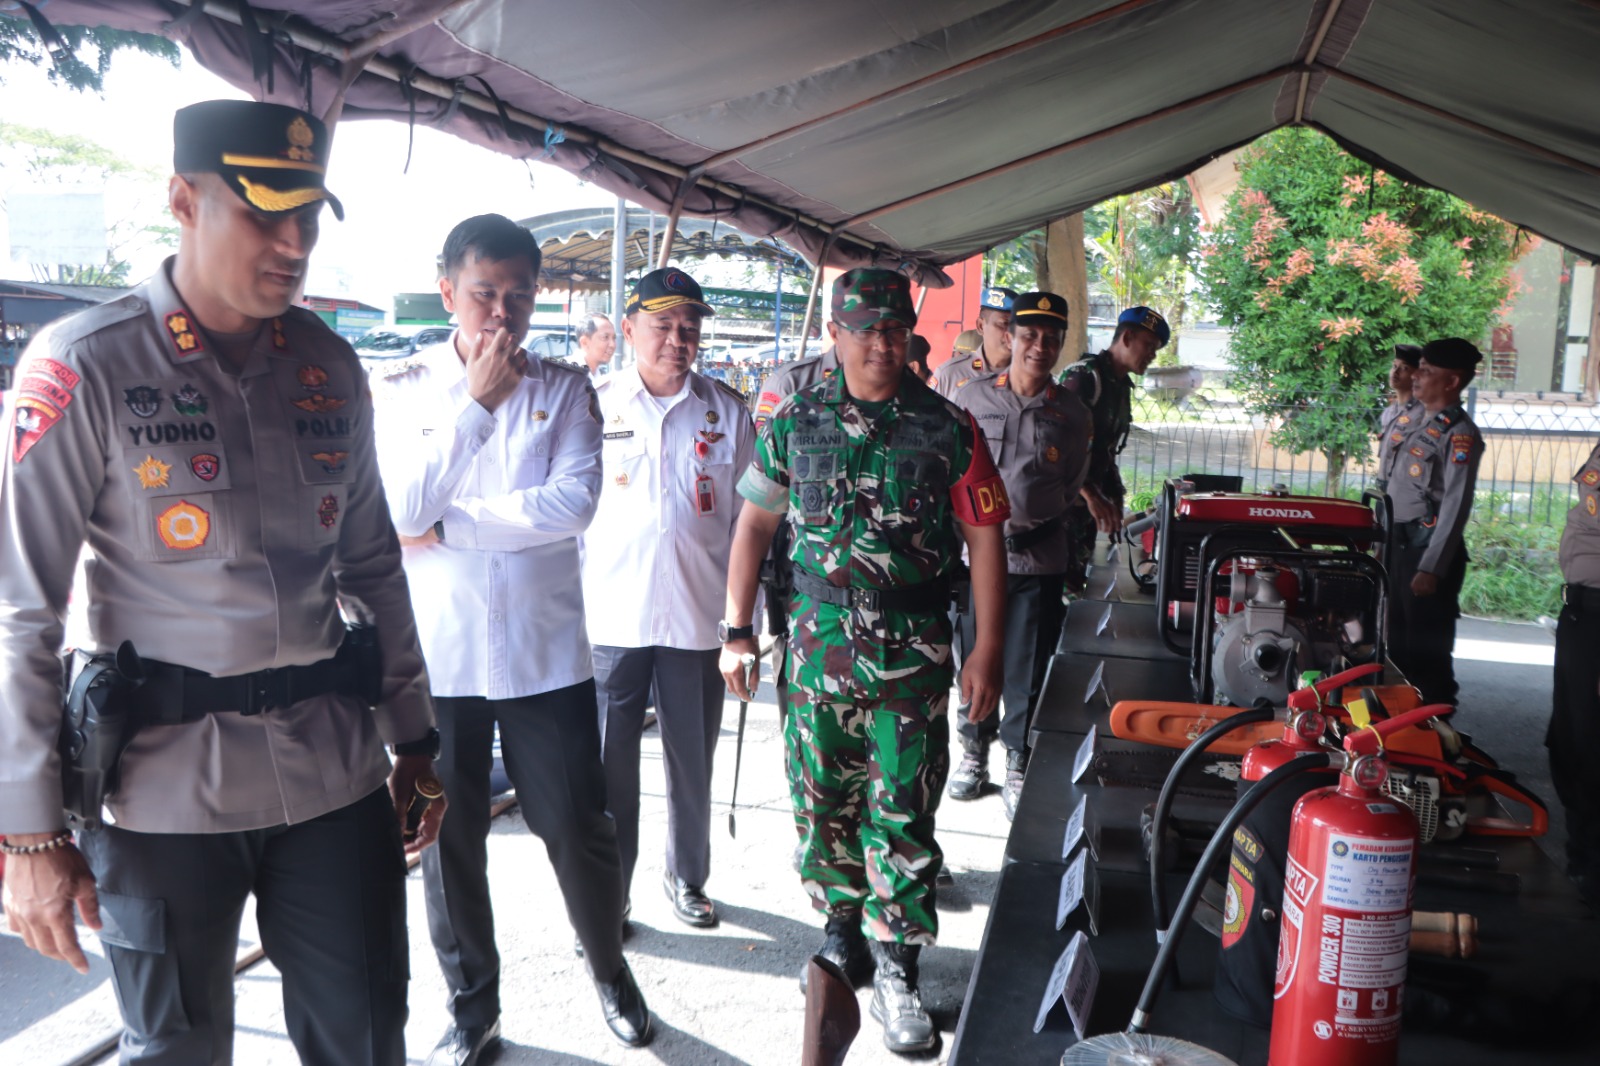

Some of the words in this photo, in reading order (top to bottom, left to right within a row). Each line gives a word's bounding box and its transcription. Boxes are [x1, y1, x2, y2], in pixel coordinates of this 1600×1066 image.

[128, 422, 216, 446] YUDHO
[295, 417, 350, 437] POLRI
[1248, 507, 1315, 519] HONDA
[1352, 853, 1378, 863] KARTU
[1329, 874, 1352, 883] UKURAN
[1322, 914, 1342, 936] 300
[1318, 936, 1340, 985] POWDER
